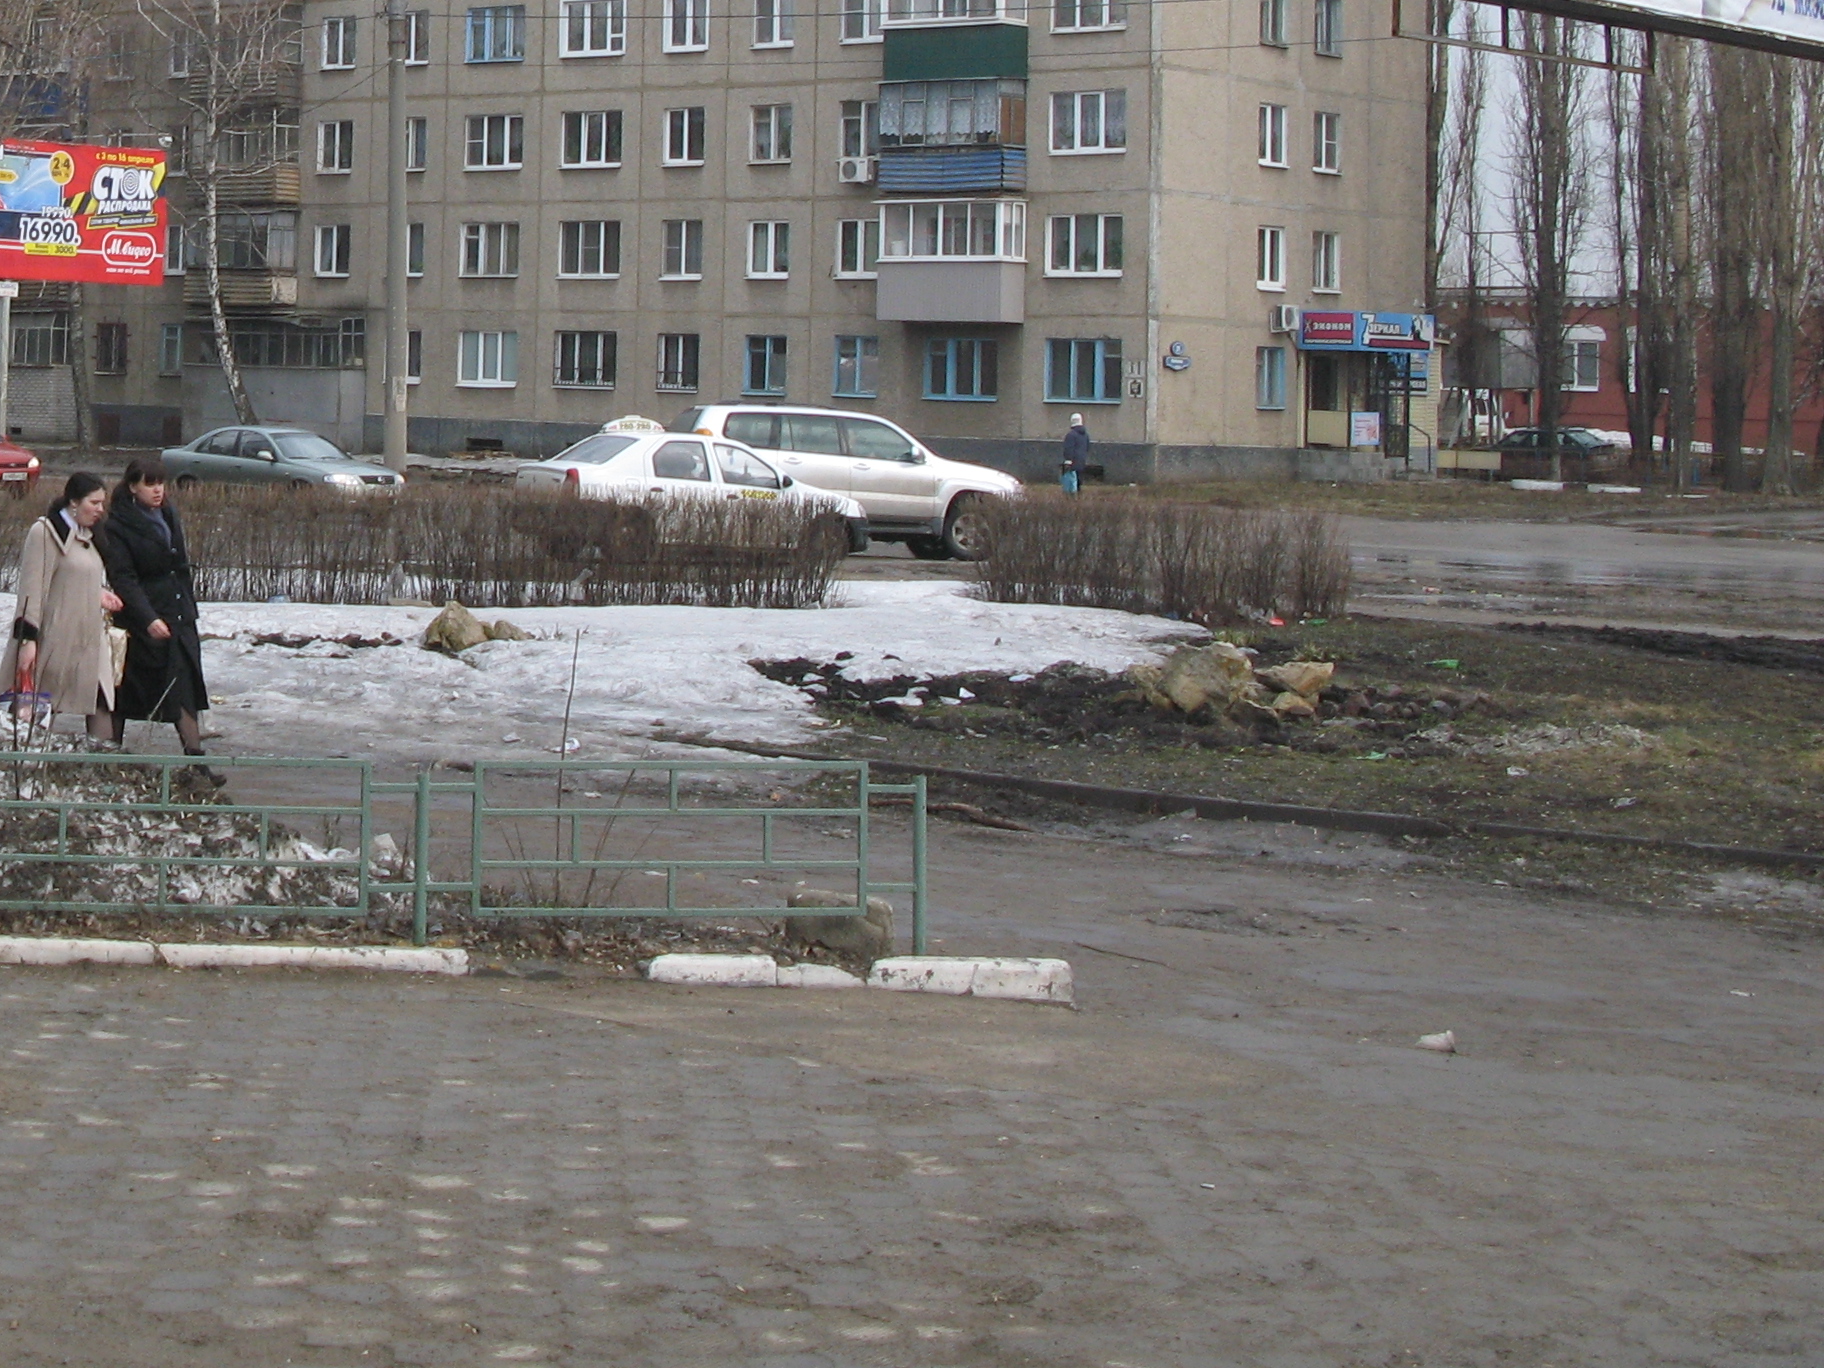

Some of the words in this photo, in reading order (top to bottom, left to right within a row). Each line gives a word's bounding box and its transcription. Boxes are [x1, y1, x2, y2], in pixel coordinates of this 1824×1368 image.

[92, 166, 155, 200] СТОК
[97, 199, 152, 215] РАСПРОДАЖА
[1368, 323, 1401, 334] ЗЕРКАЛ
